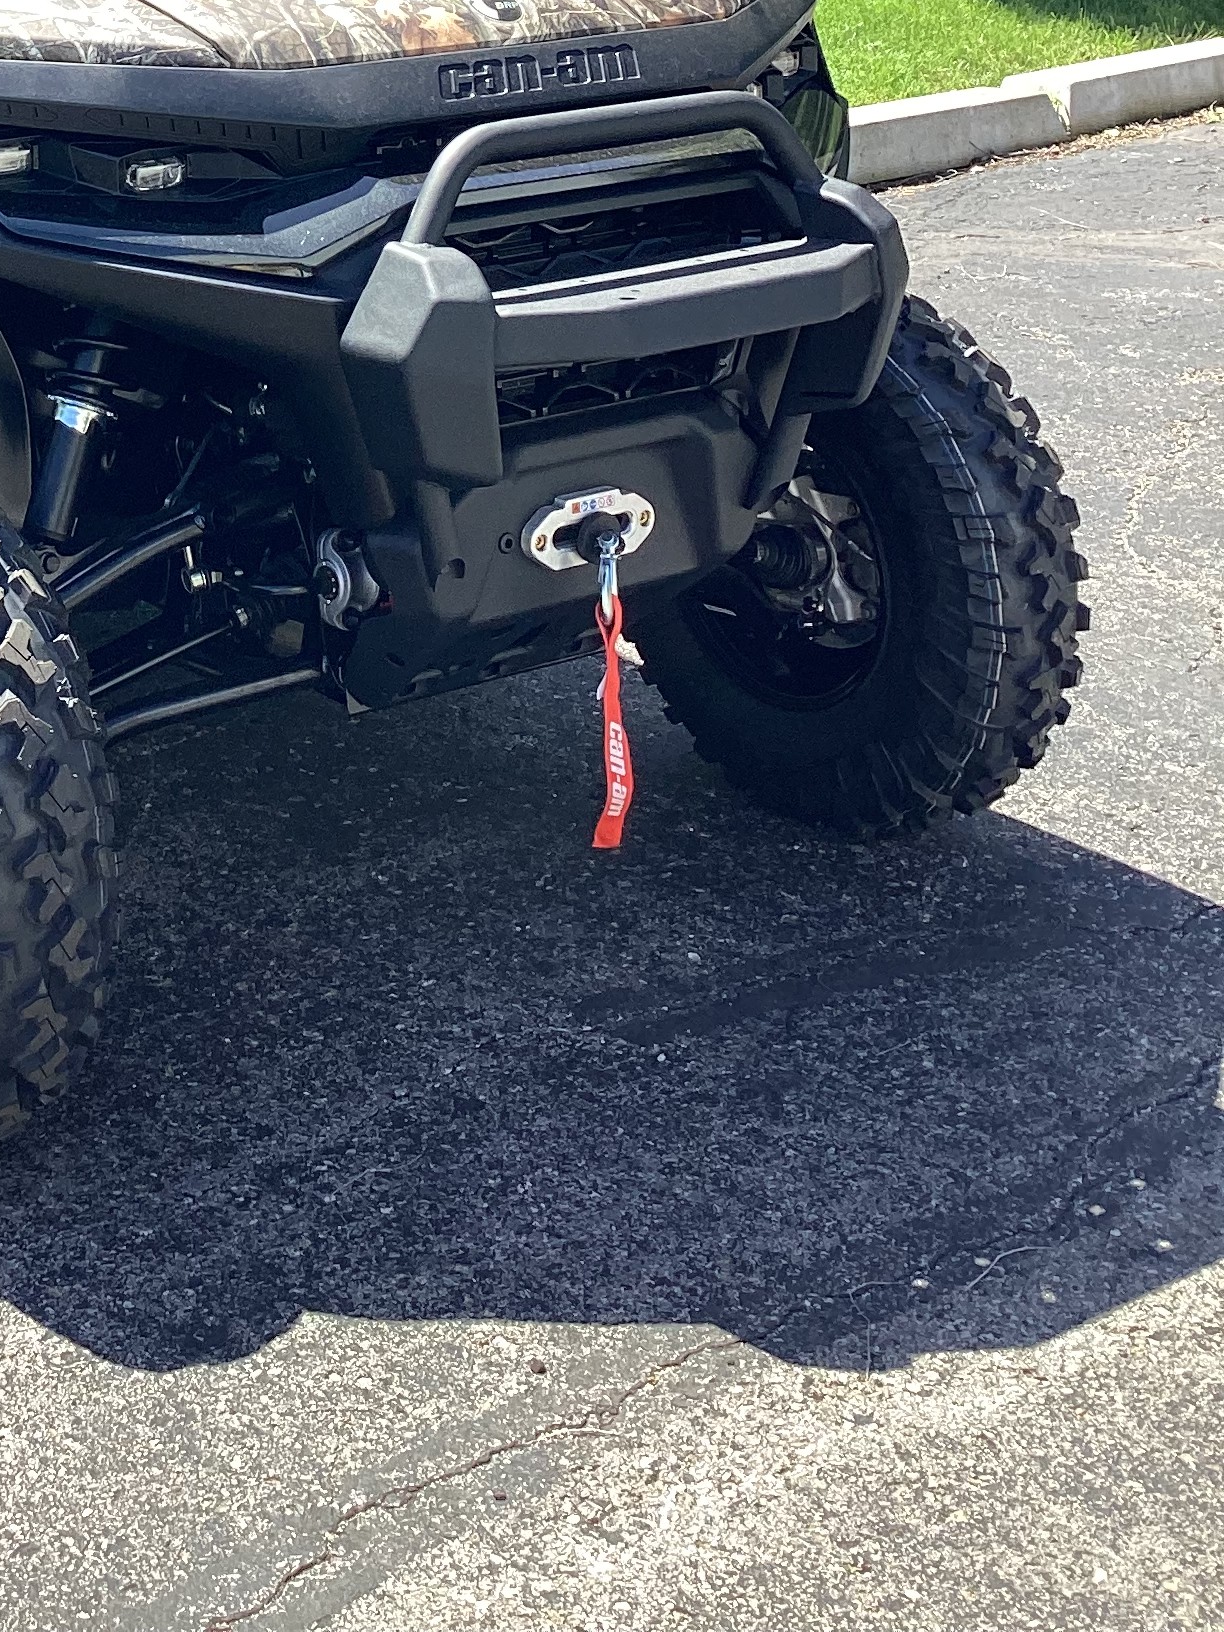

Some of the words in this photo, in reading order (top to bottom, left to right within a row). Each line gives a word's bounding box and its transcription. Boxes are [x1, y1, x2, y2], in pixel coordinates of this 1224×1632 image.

[495, 1, 519, 10] BRP
[438, 44, 641, 102] can-am
[607, 721, 627, 817] can-am
